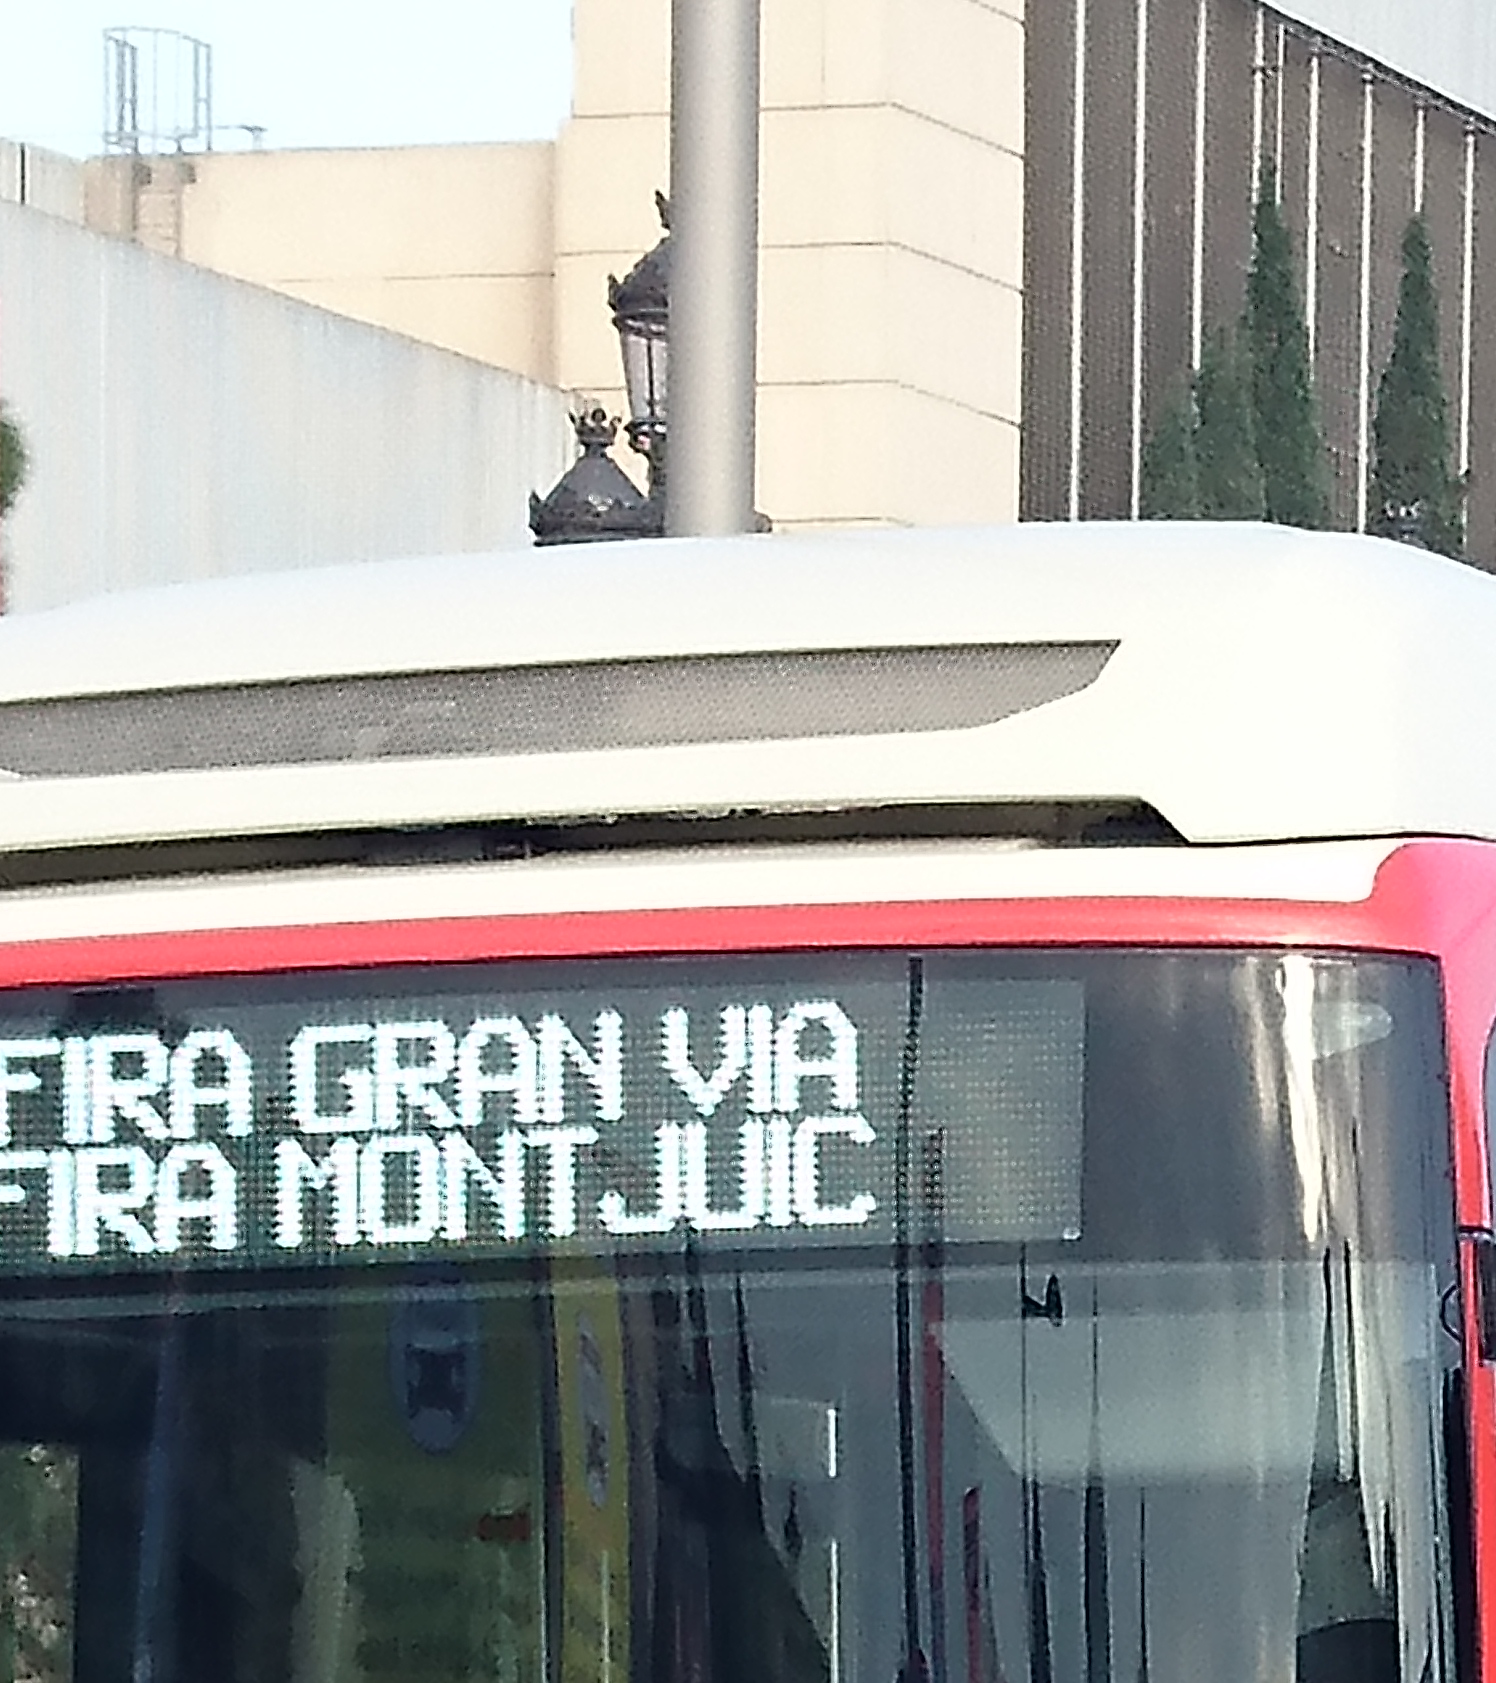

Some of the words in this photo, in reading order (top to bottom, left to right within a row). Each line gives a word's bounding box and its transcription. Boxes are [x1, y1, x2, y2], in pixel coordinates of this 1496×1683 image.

[289, 1008, 624, 1133] GRAN
[661, 1000, 859, 1115] VIA
[270, 1113, 877, 1249] MONTJUIC
